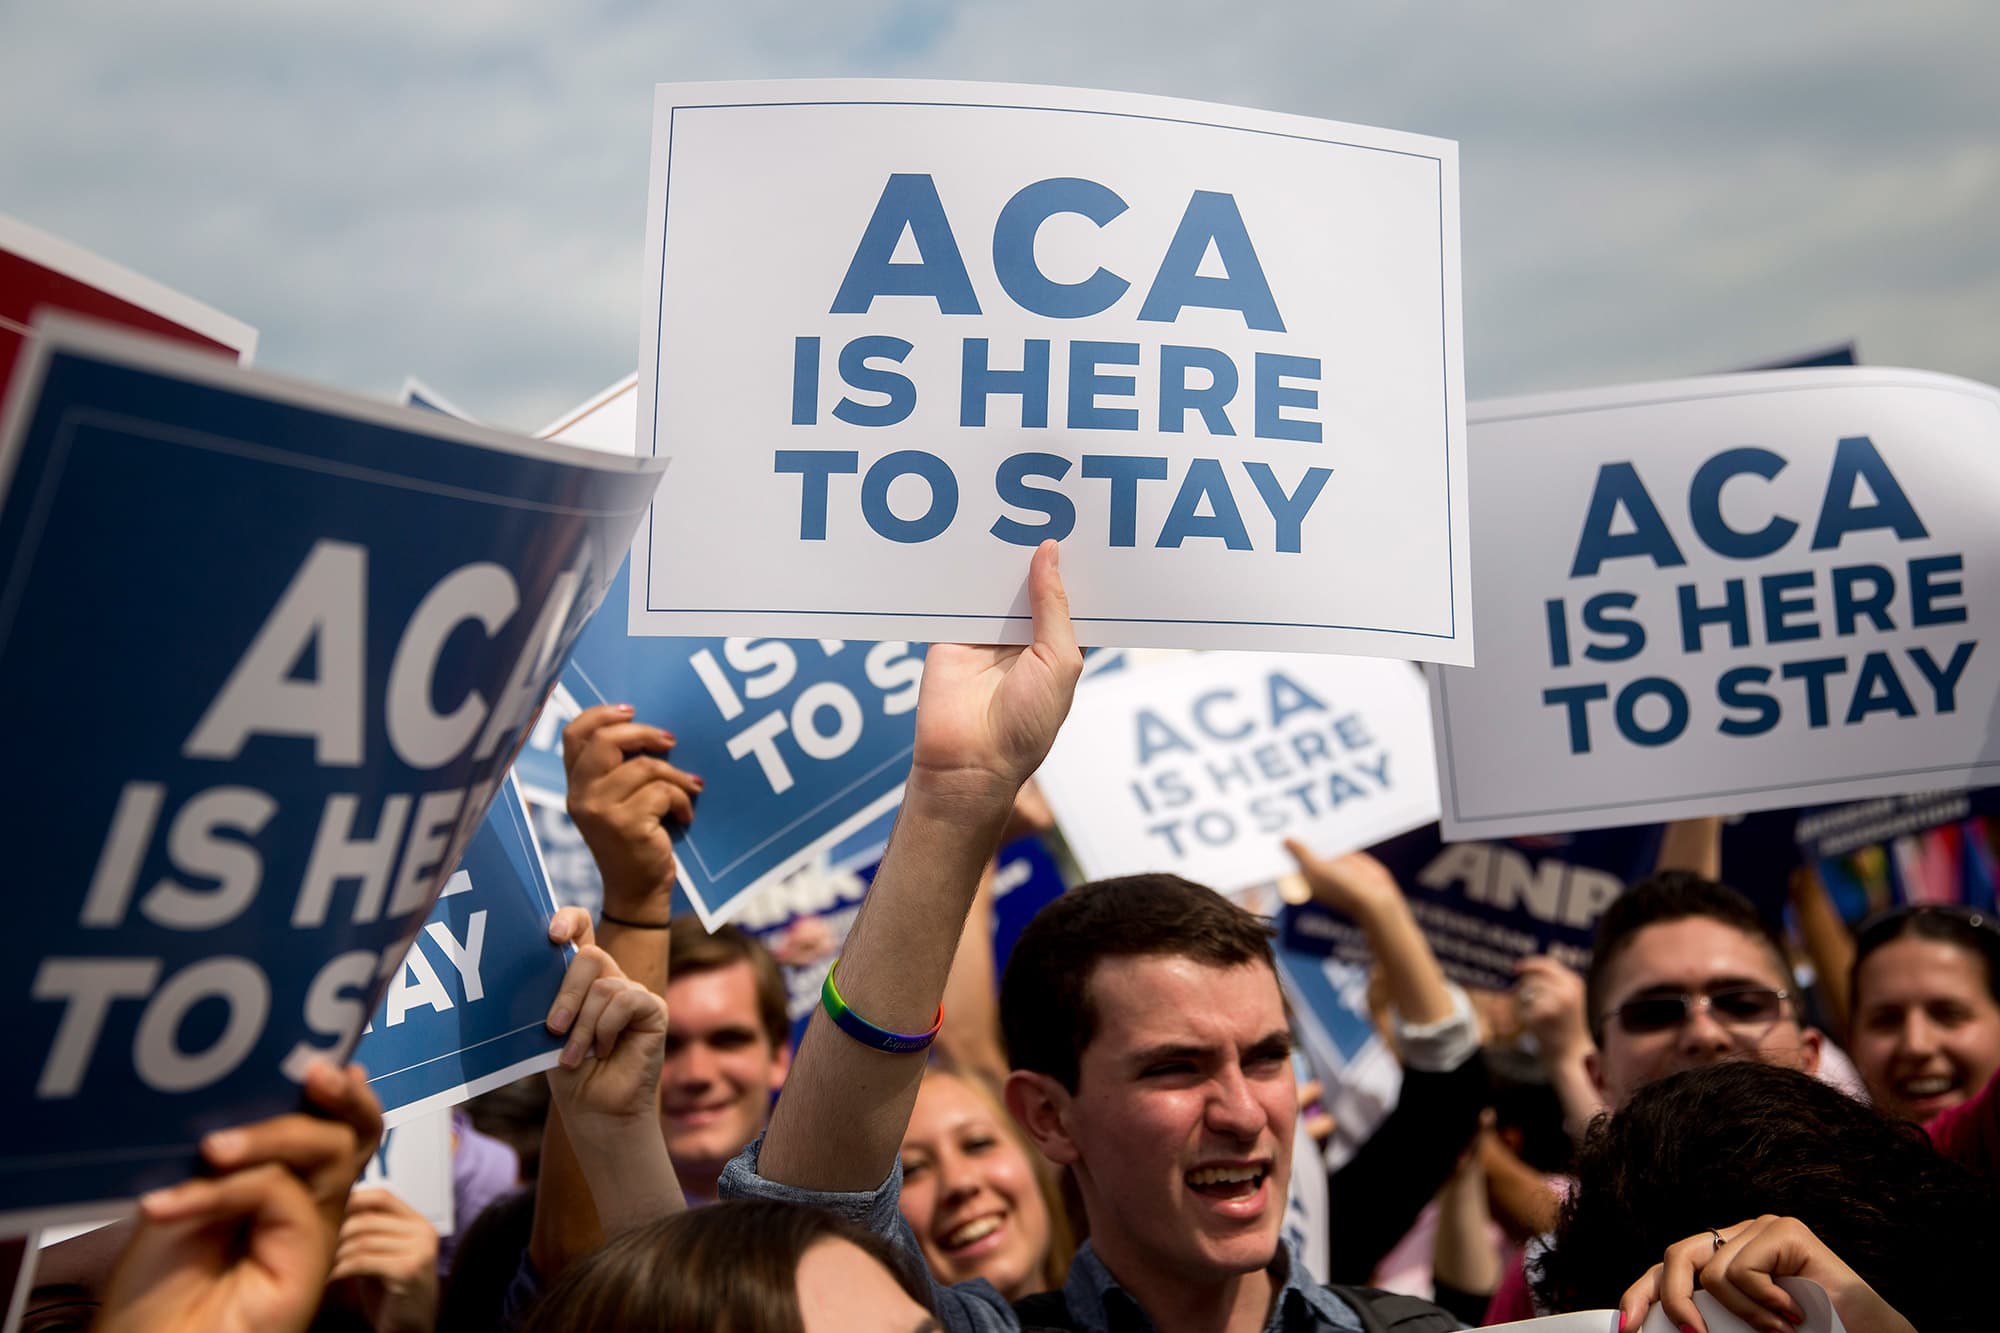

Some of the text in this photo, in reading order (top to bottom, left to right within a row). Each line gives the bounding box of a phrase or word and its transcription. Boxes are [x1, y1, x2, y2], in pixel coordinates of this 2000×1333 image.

[829, 173, 1287, 333] ACA
[792, 336, 1323, 444] IS HERE
[774, 450, 1334, 554] TO STAY
[1569, 436, 1930, 578] ACA
[1546, 553, 1967, 668] IS HERE
[689, 637, 797, 721] IS
[1133, 667, 1329, 765] ACA
[1542, 641, 1978, 754] TO STAY
[725, 681, 864, 795] TO
[1130, 711, 1376, 814] IS HERE
[80, 781, 279, 930] IS
[1148, 751, 1395, 859] TO STAY
[31, 956, 271, 1098] TO
[361, 909, 487, 1035] AY
